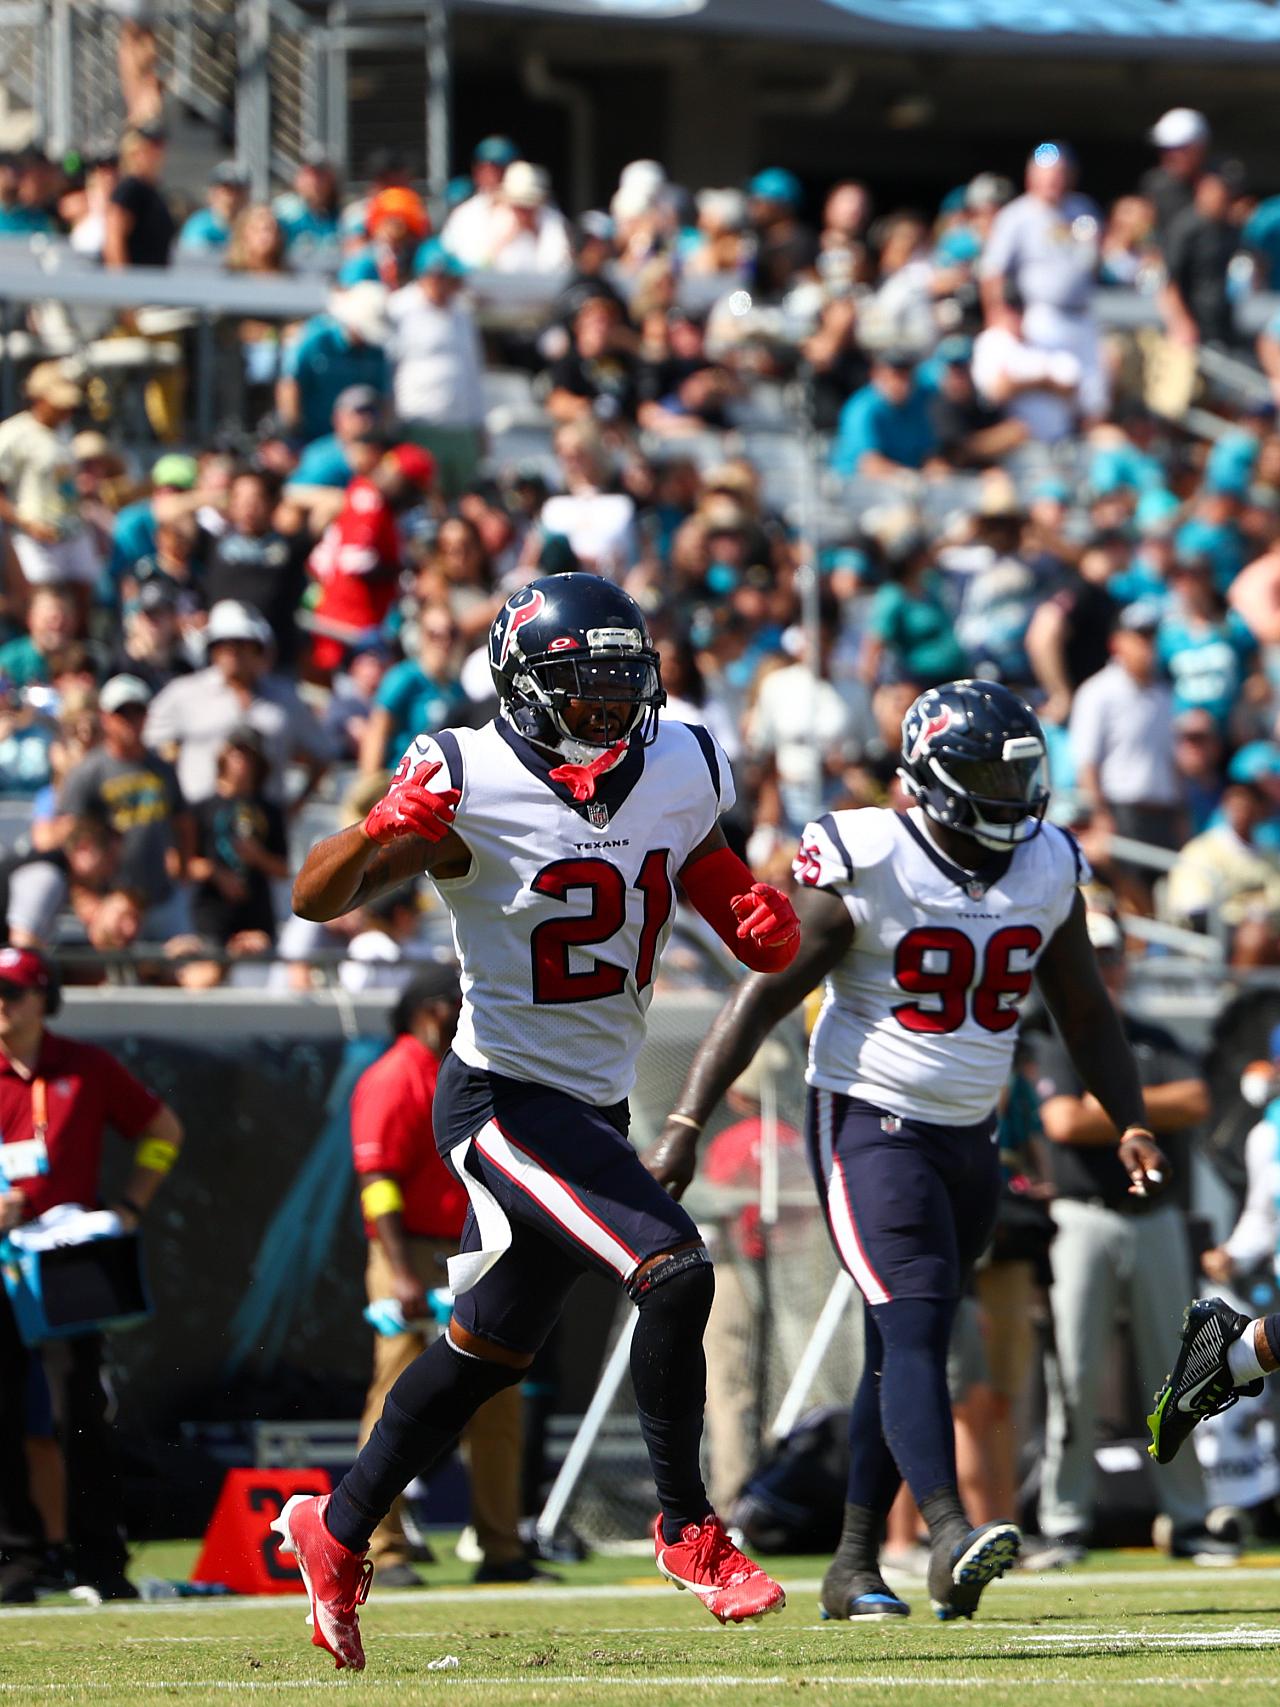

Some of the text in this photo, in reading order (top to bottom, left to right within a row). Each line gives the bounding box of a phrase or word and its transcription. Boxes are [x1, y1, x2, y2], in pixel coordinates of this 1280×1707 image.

[574, 838, 630, 851] TEXANS
[530, 848, 673, 1004] 21
[889, 924, 1043, 1034] 96
